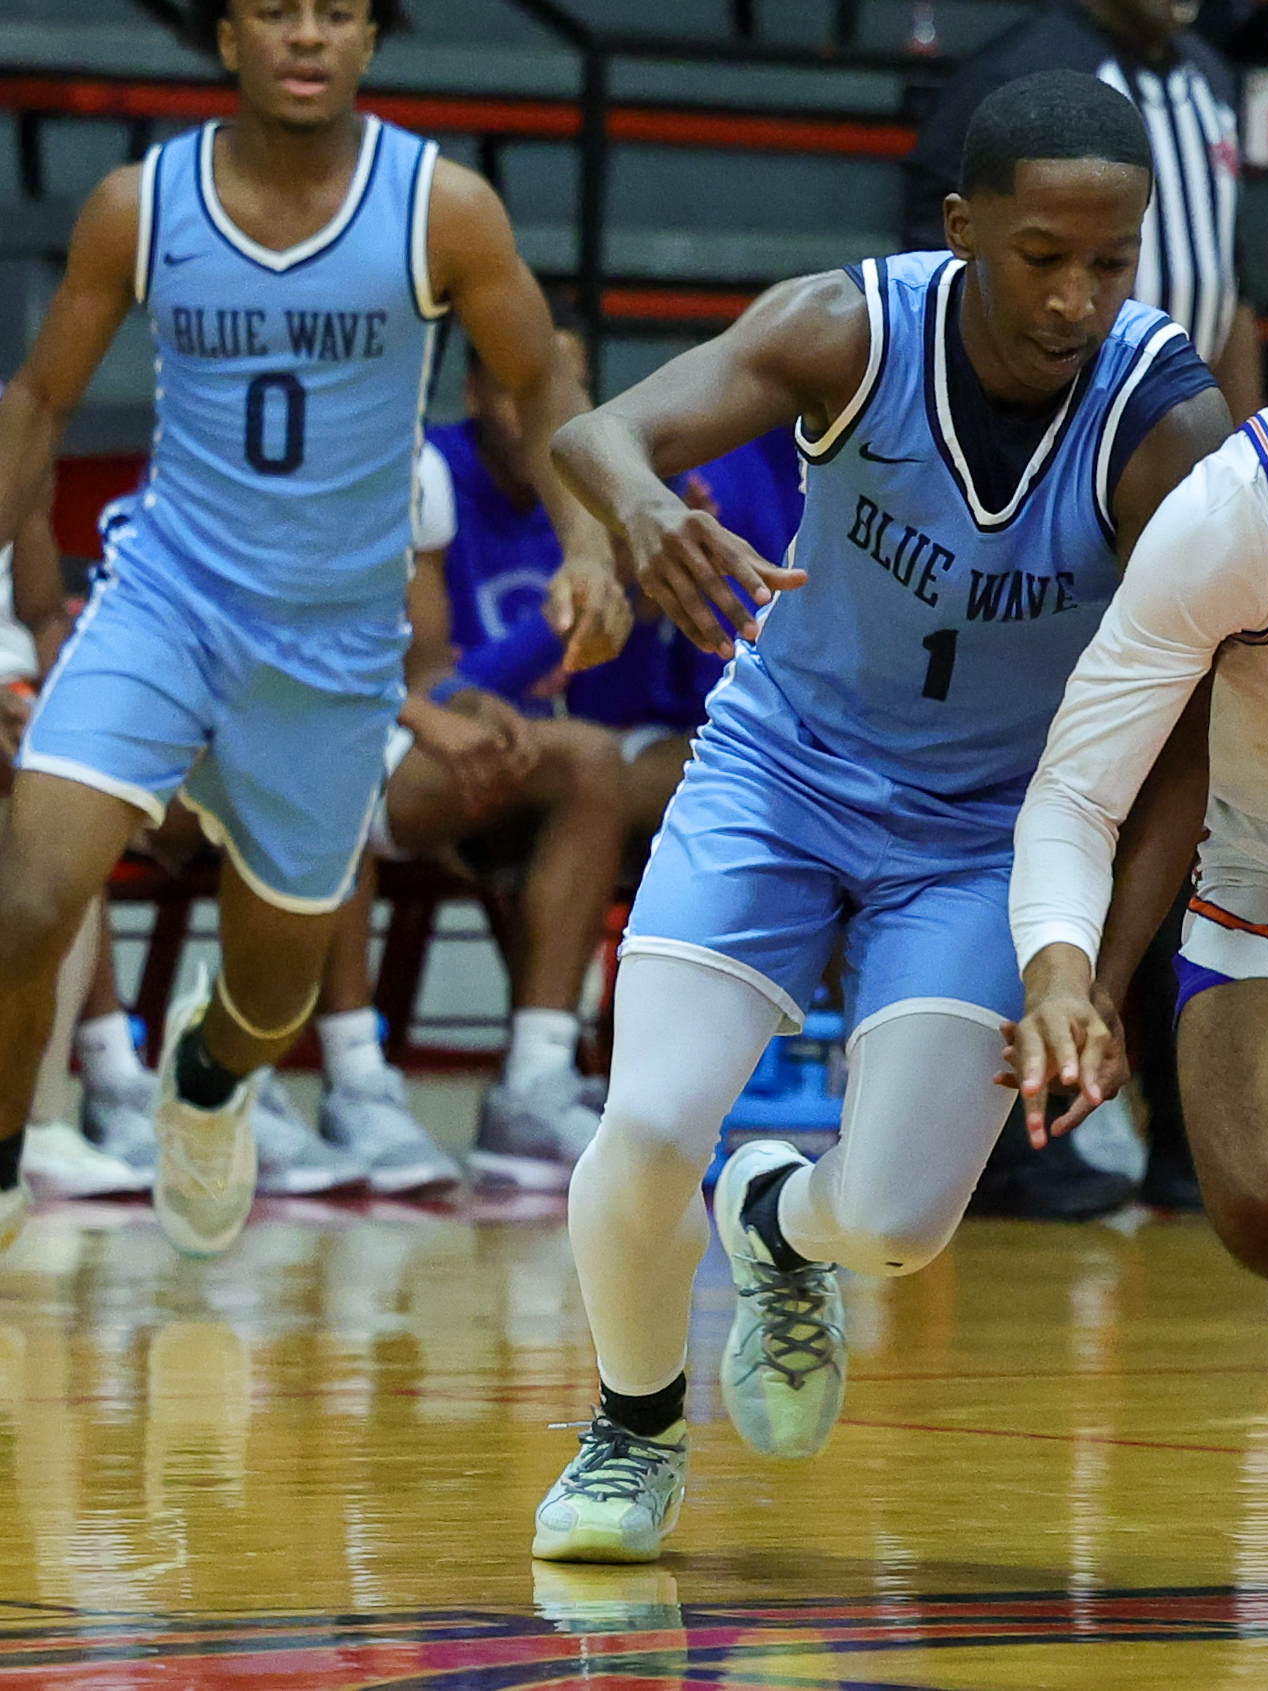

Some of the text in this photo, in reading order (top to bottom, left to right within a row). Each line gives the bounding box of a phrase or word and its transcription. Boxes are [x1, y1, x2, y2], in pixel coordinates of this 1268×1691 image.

[172, 307, 388, 362] BLUE WAVE
[245, 371, 306, 475] 0
[847, 494, 1078, 622] BLUE WAVE
[921, 628, 959, 702] 1
